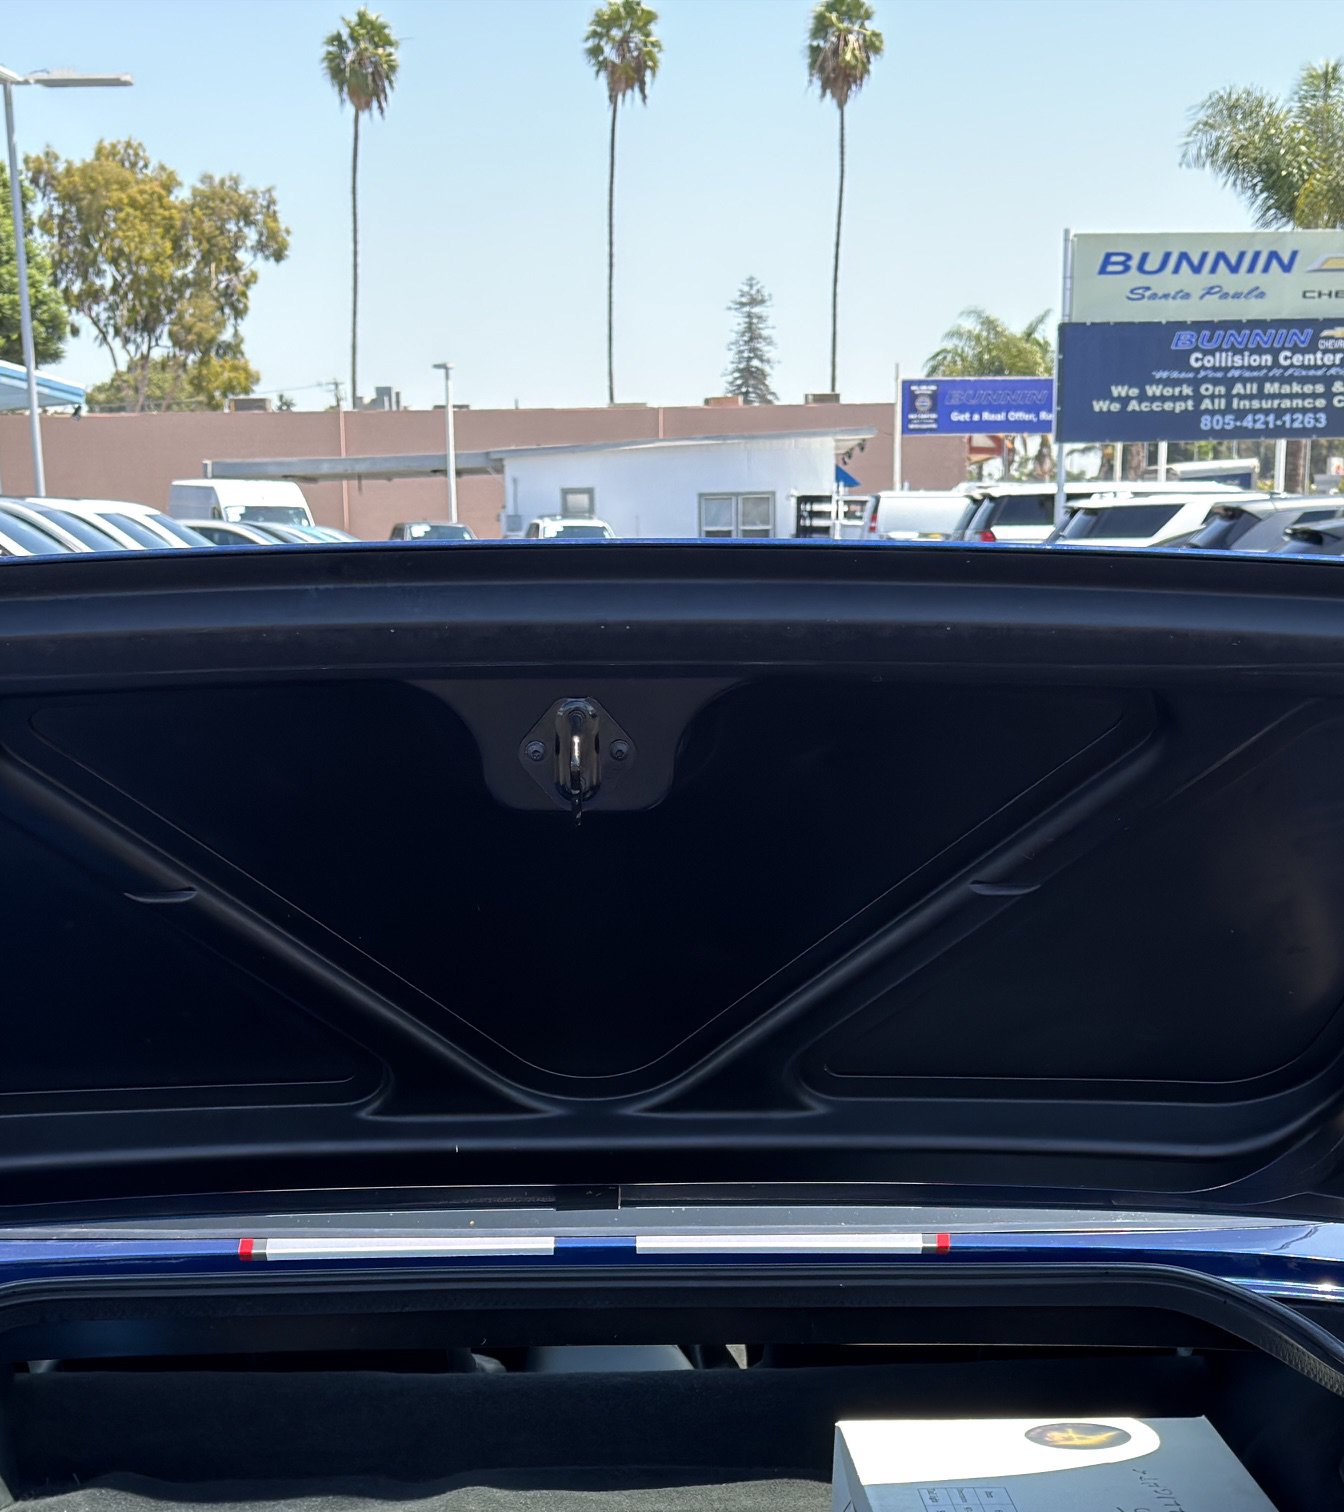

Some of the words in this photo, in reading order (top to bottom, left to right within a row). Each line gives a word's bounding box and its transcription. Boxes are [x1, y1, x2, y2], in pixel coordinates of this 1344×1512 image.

[1097, 249, 1299, 276] BUNNIN
[1126, 286, 1193, 302] Santa
[1199, 285, 1267, 301] Paula
[1170, 328, 1314, 350] BUNNIN
[1189, 351, 1273, 367] Collision
[1278, 350, 1344, 366] Center
[944, 389, 1049, 405] BUNNIN
[1110, 384, 1140, 397] We
[1145, 383, 1194, 397] Work
[1199, 383, 1226, 396] On
[1231, 381, 1258, 395] All
[1263, 381, 1326, 394] Makes
[1092, 399, 1122, 412] We
[1126, 399, 1195, 414] Accept
[1199, 397, 1226, 411] All
[1231, 396, 1327, 410] Insurance
[950, 411, 972, 422] Get
[981, 411, 1006, 421] Real
[1199, 412, 1328, 431] 805-421-1263
